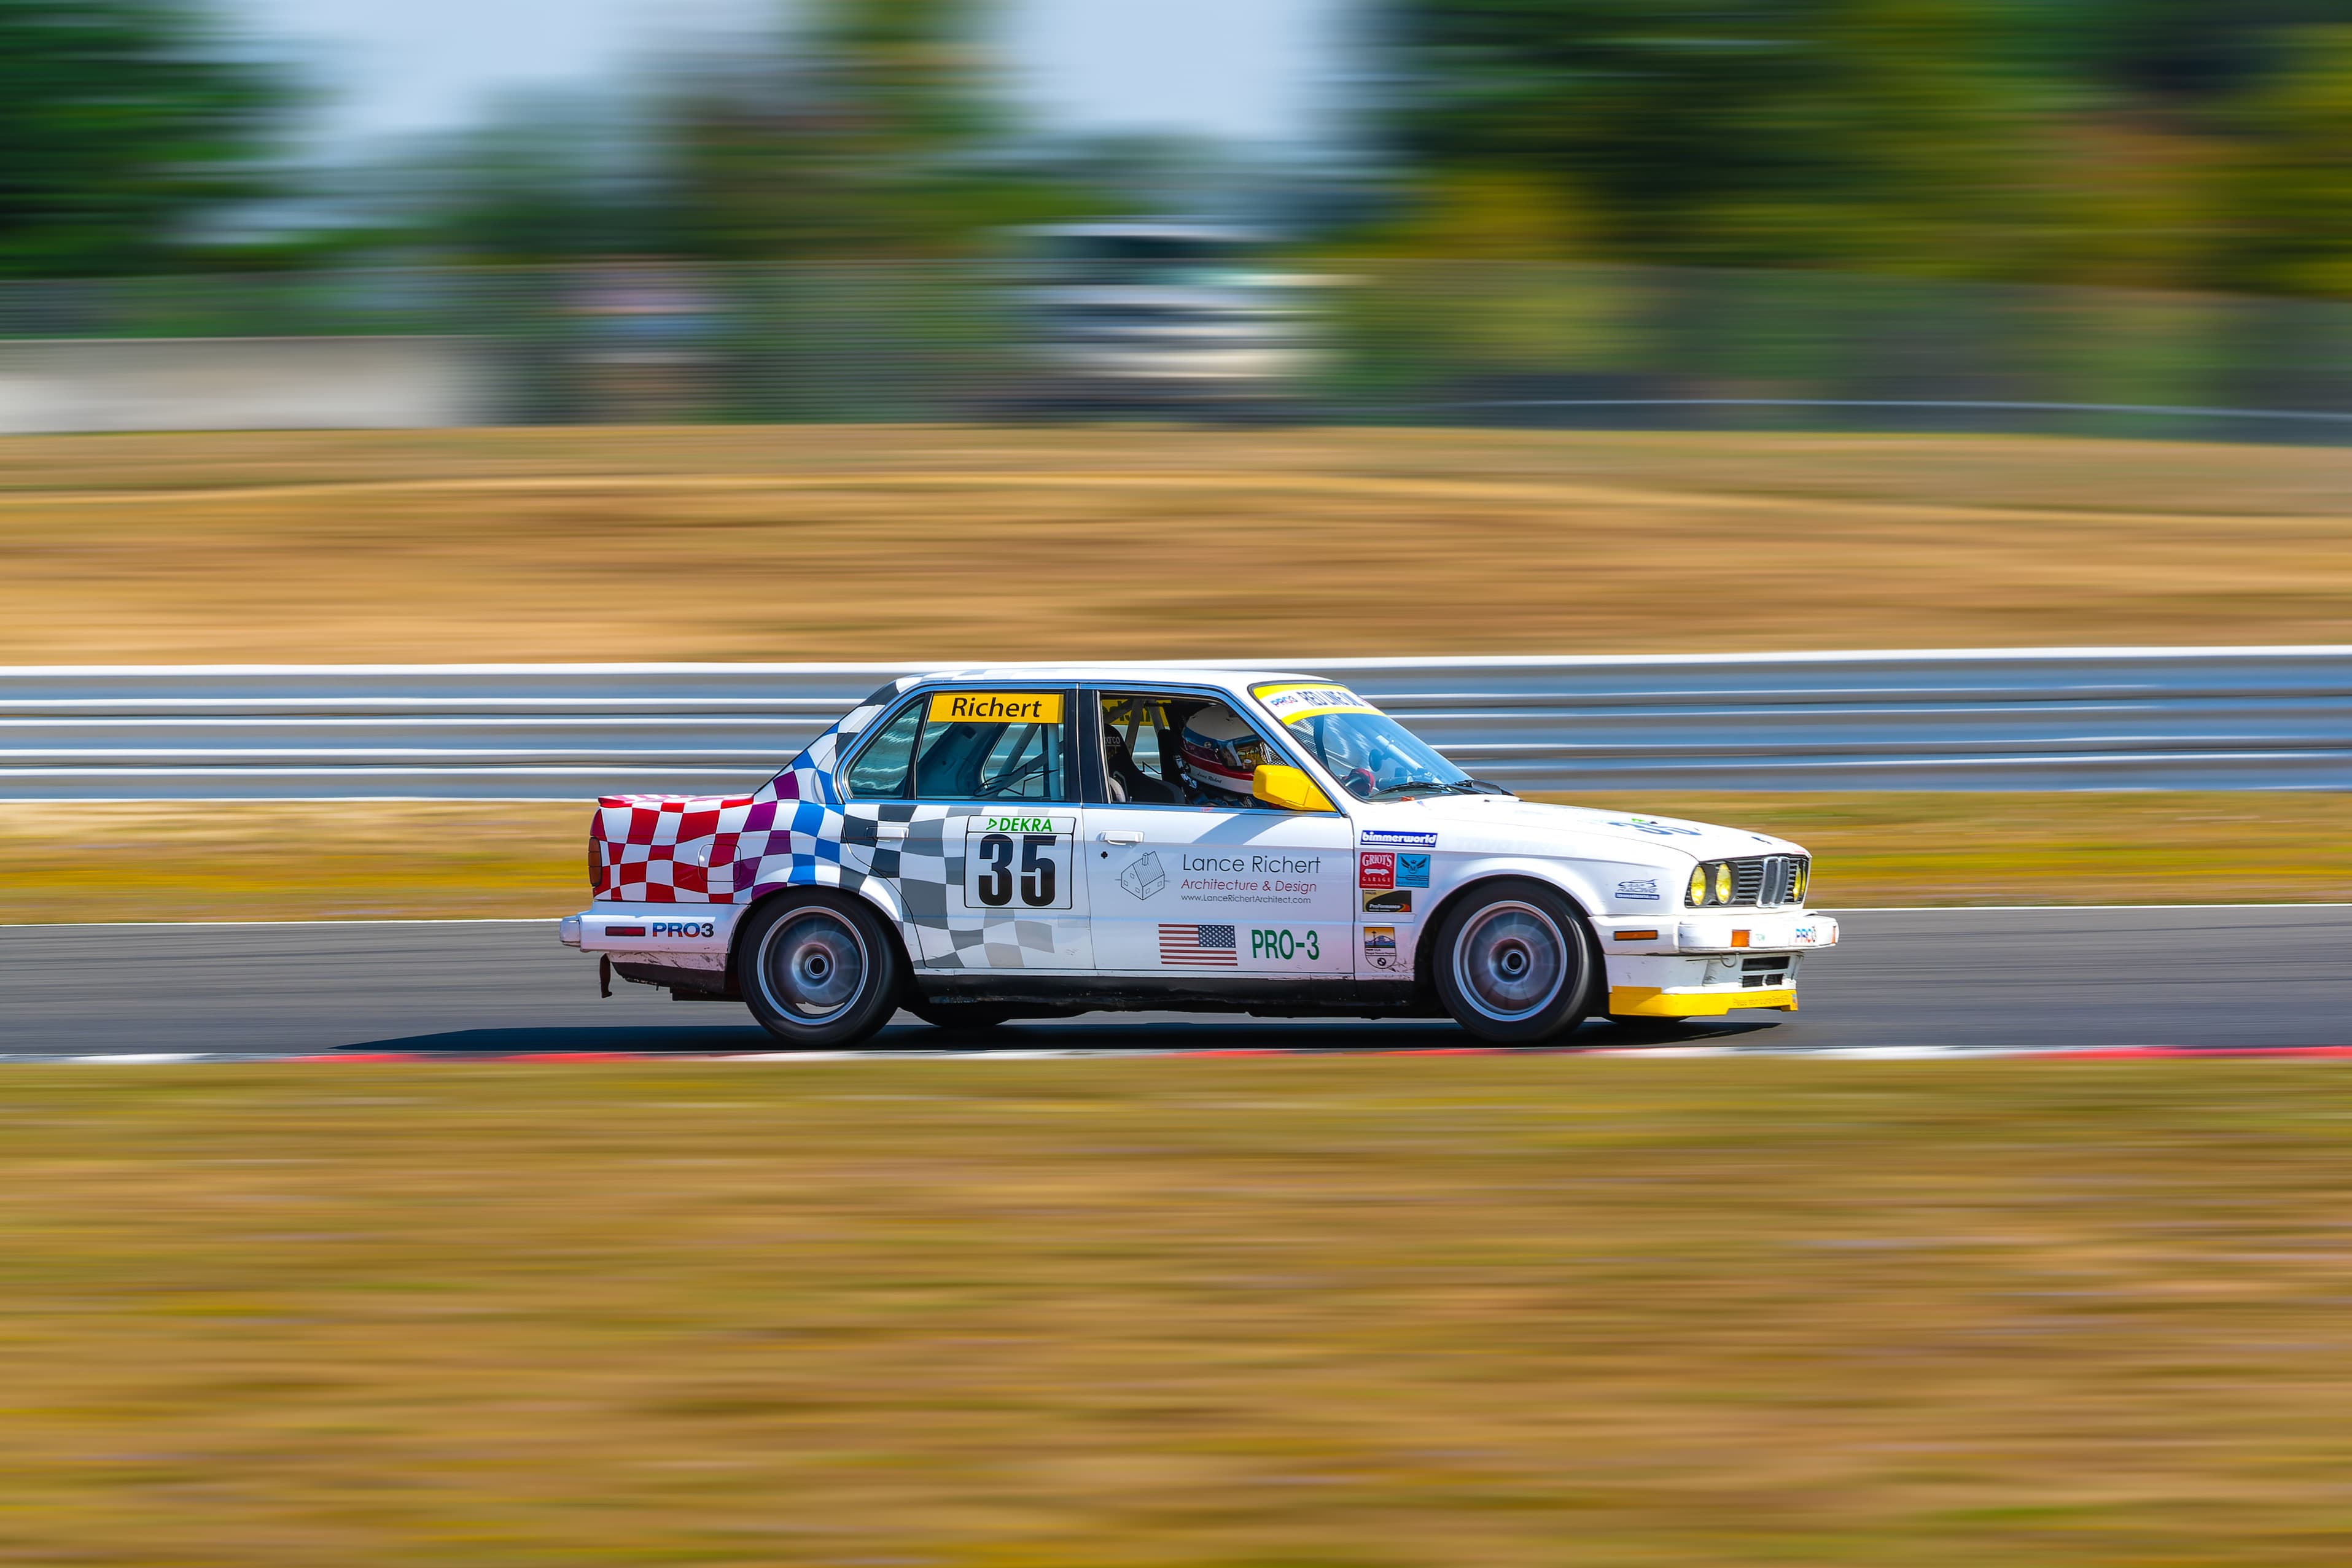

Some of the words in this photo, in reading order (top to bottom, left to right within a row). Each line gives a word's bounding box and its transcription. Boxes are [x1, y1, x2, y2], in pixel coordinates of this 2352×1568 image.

[1296, 691, 1328, 706] RED
[951, 697, 1042, 717] Richert
[999, 818, 1052, 831] DEKRA
[1362, 831, 1436, 844] bimmerworld
[1183, 854, 1244, 872] Lance
[1252, 855, 1320, 874] Richert
[1361, 854, 1392, 867] GRIOT'S
[978, 834, 1057, 906] 35
[1181, 879, 1258, 890] Architecture
[1262, 880, 1271, 891] &
[1275, 880, 1317, 895] Design
[1181, 894, 1311, 904] www.LanceRichertArchitect.com
[652, 922, 714, 937] PRO3
[1252, 929, 1319, 960] PRO-3
